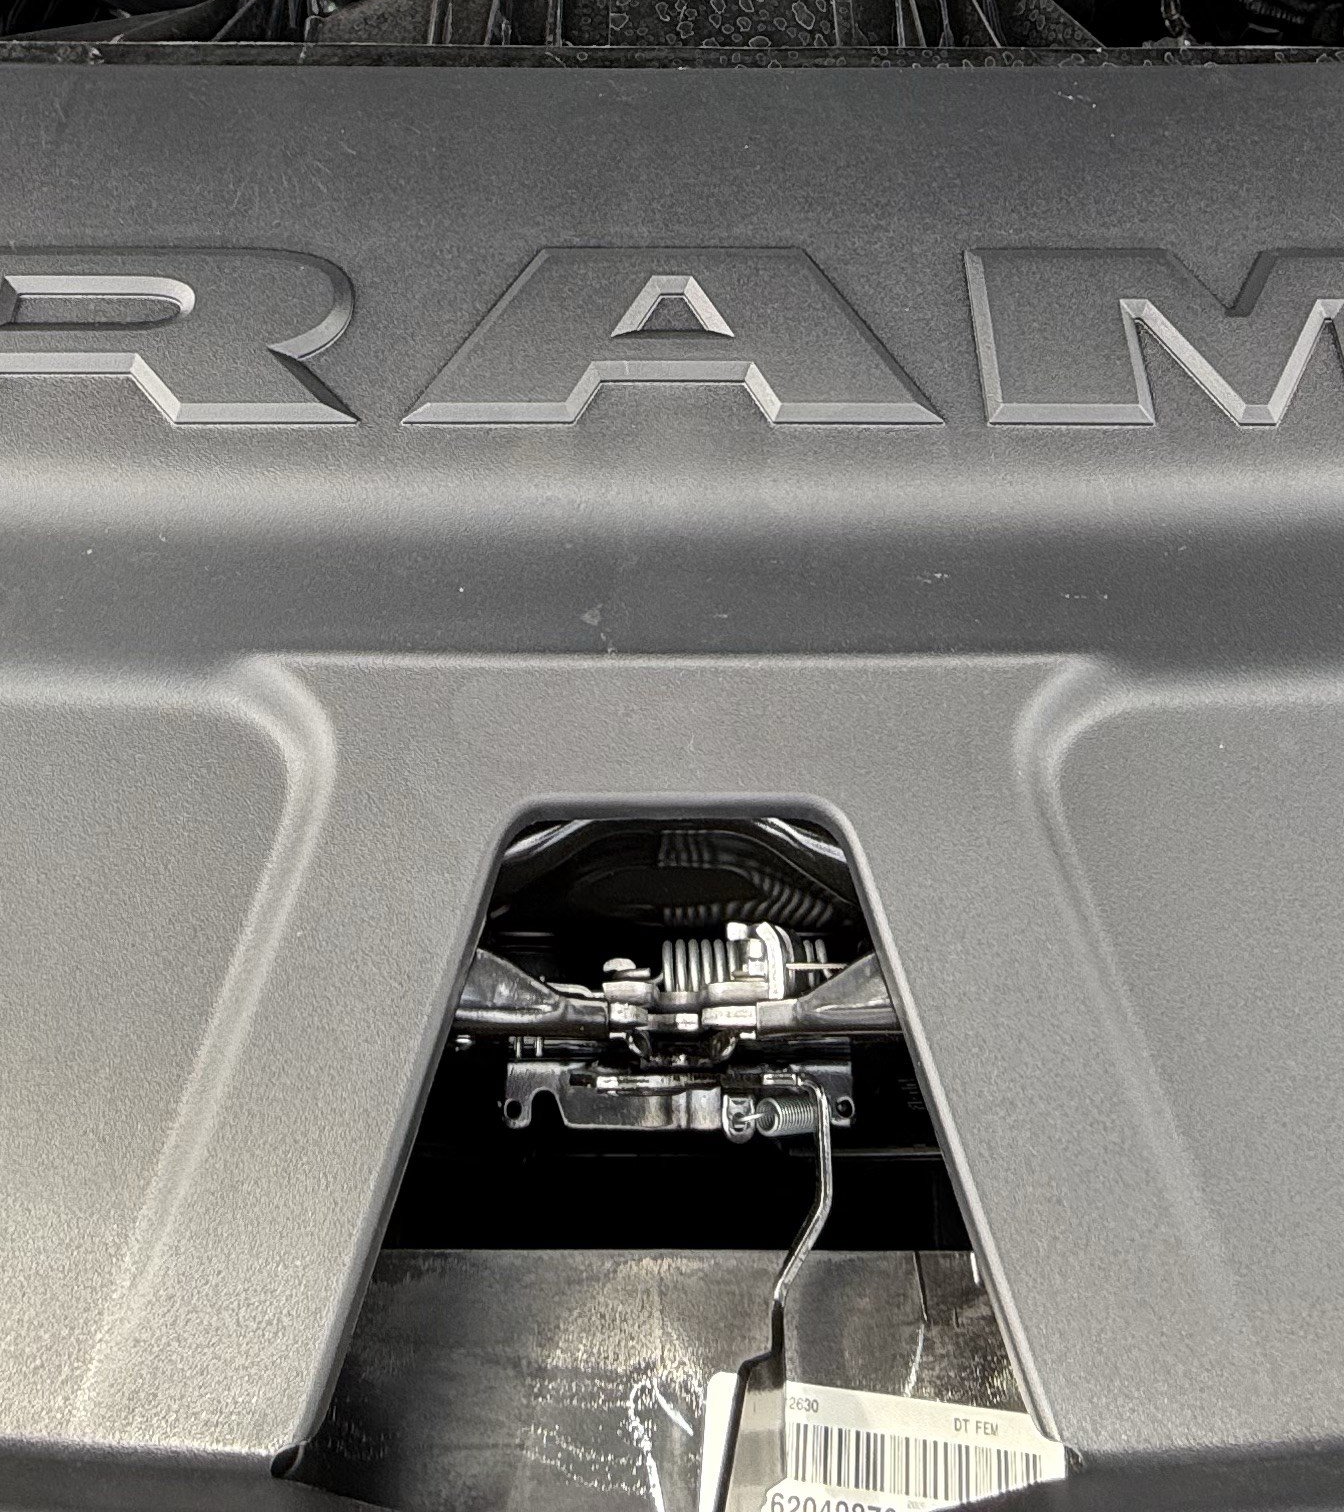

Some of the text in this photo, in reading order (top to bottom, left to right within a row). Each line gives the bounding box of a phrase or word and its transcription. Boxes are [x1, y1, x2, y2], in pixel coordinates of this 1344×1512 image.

[785, 1396, 820, 1414] 2630
[953, 1416, 1000, 1437] DT FEM
